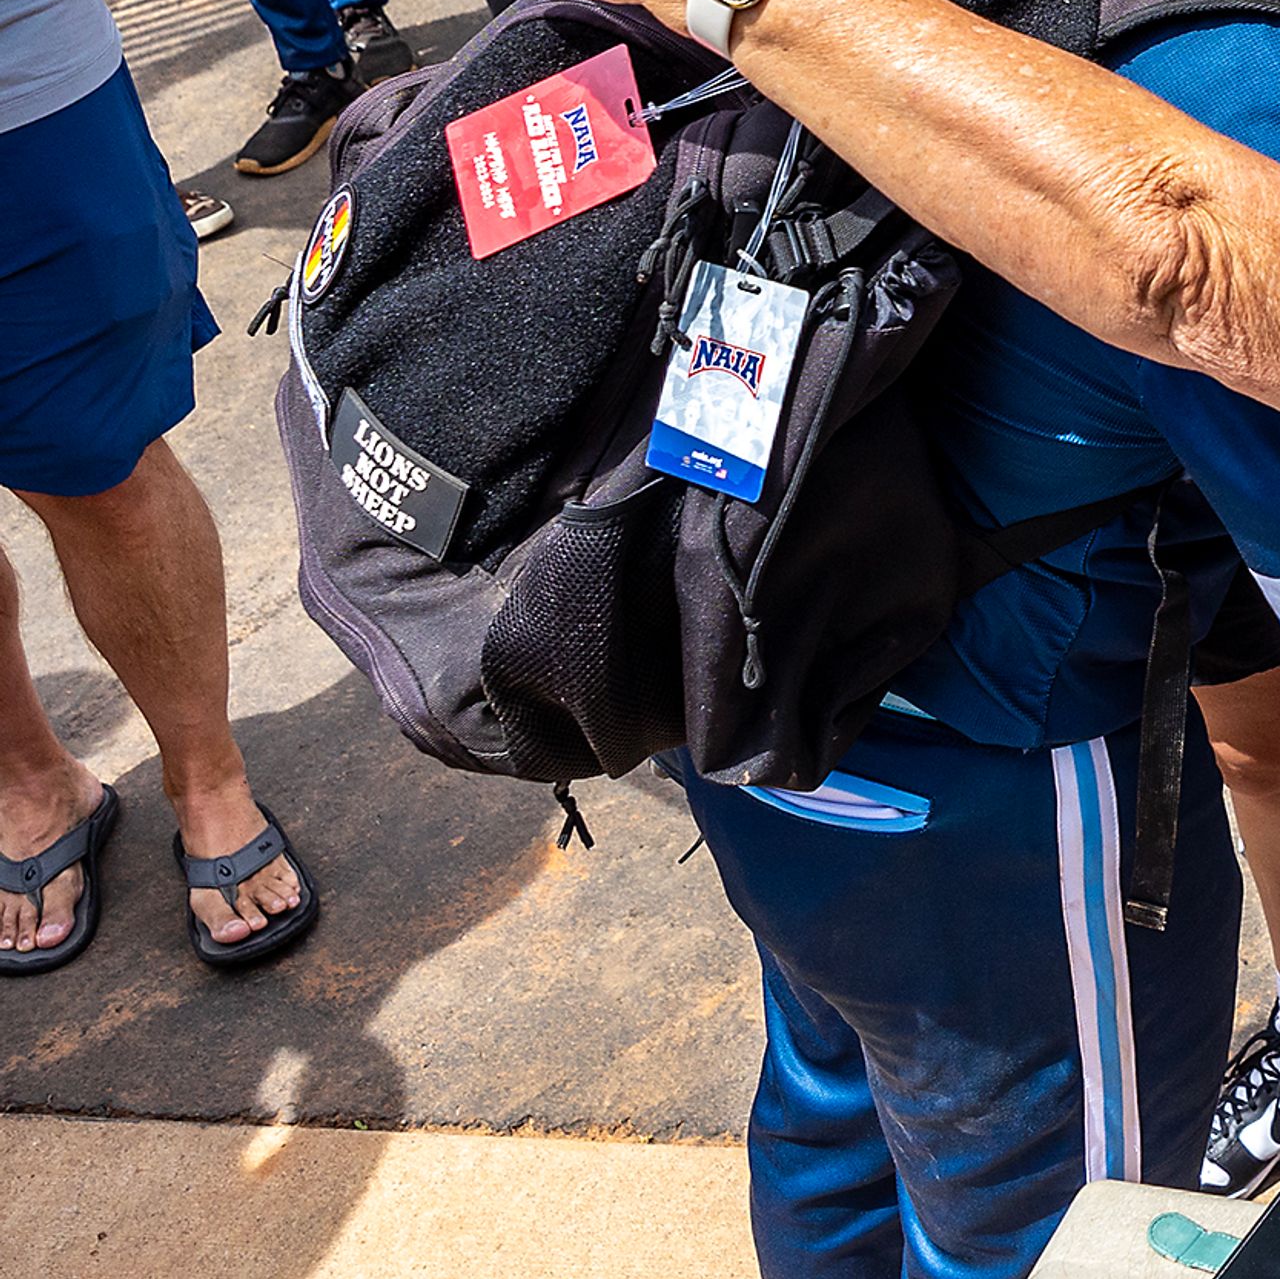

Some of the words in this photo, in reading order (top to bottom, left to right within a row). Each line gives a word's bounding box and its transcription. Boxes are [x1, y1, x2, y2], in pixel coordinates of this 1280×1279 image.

[522, 103, 546, 138] RED
[564, 104, 598, 171] NAIA
[530, 138, 563, 209] BANNER
[692, 339, 760, 390] NAIA
[353, 418, 431, 491] LIONS
[354, 451, 410, 506] NOT
[341, 463, 416, 534] SHEEP
